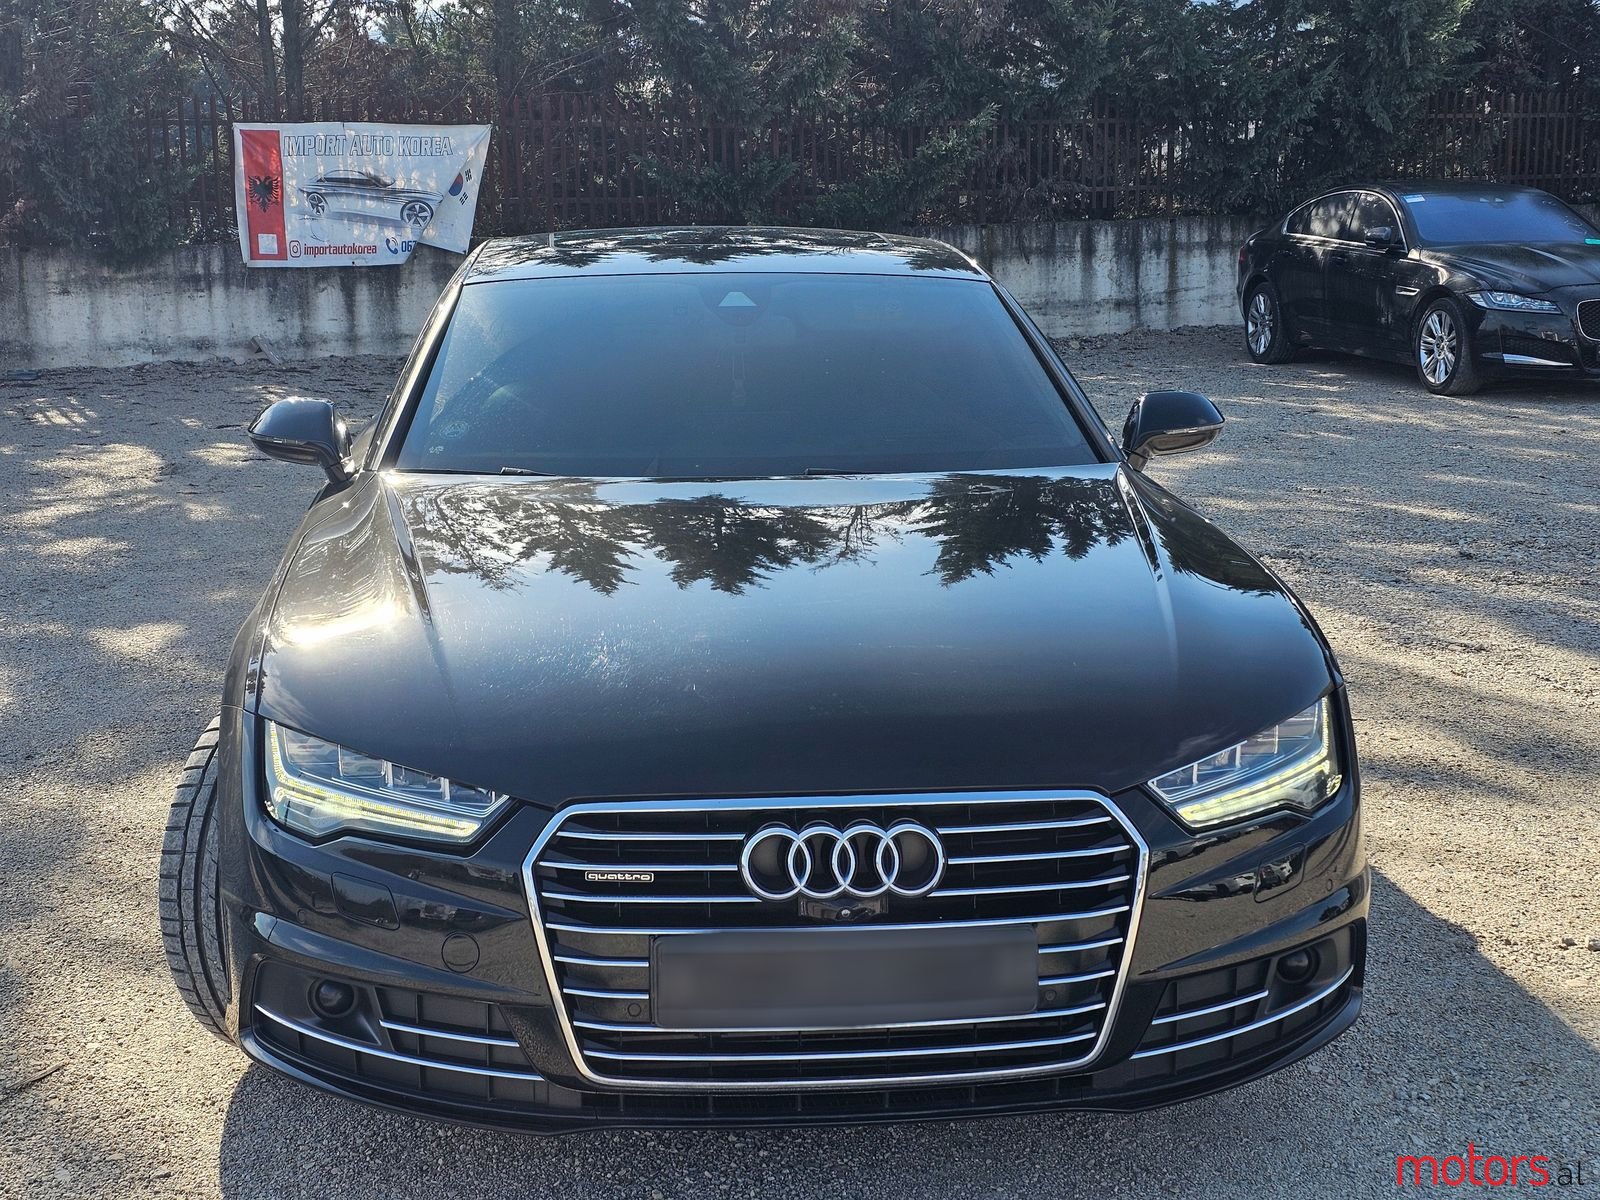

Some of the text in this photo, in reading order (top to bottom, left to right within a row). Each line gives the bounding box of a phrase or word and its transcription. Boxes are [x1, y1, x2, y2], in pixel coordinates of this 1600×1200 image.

[283, 135, 453, 156] IMPORT AUTO KOREA
[303, 242, 377, 257] importautokorea
[588, 873, 651, 881] quattro
